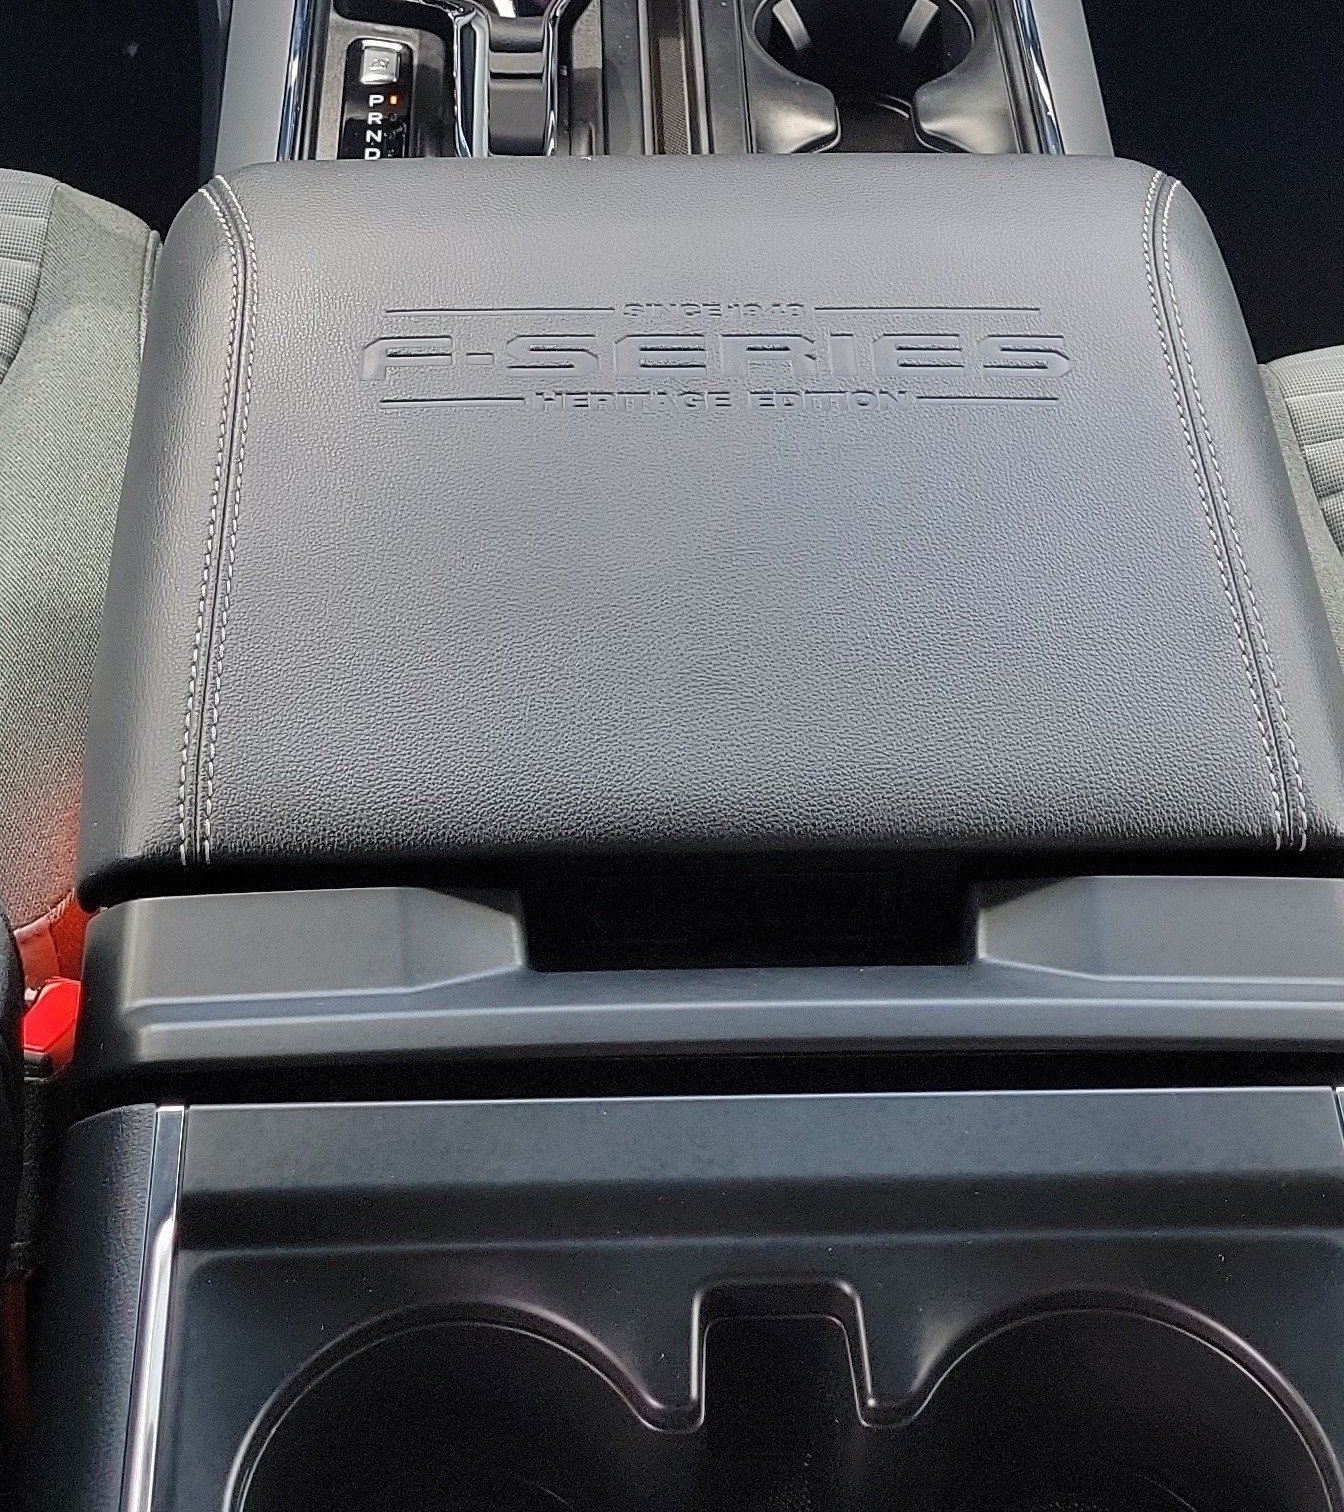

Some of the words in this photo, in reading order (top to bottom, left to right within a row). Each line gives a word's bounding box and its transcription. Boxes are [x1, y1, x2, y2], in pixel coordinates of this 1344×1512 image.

[368, 95, 385, 107] P
[367, 113, 383, 125] R
[366, 130, 382, 143] N
[364, 148, 381, 160] D
[623, 303, 722, 318] SINCE
[362, 333, 1074, 381] F-SERIES
[534, 390, 733, 410] HERITAGE
[747, 390, 914, 410] EDITION
